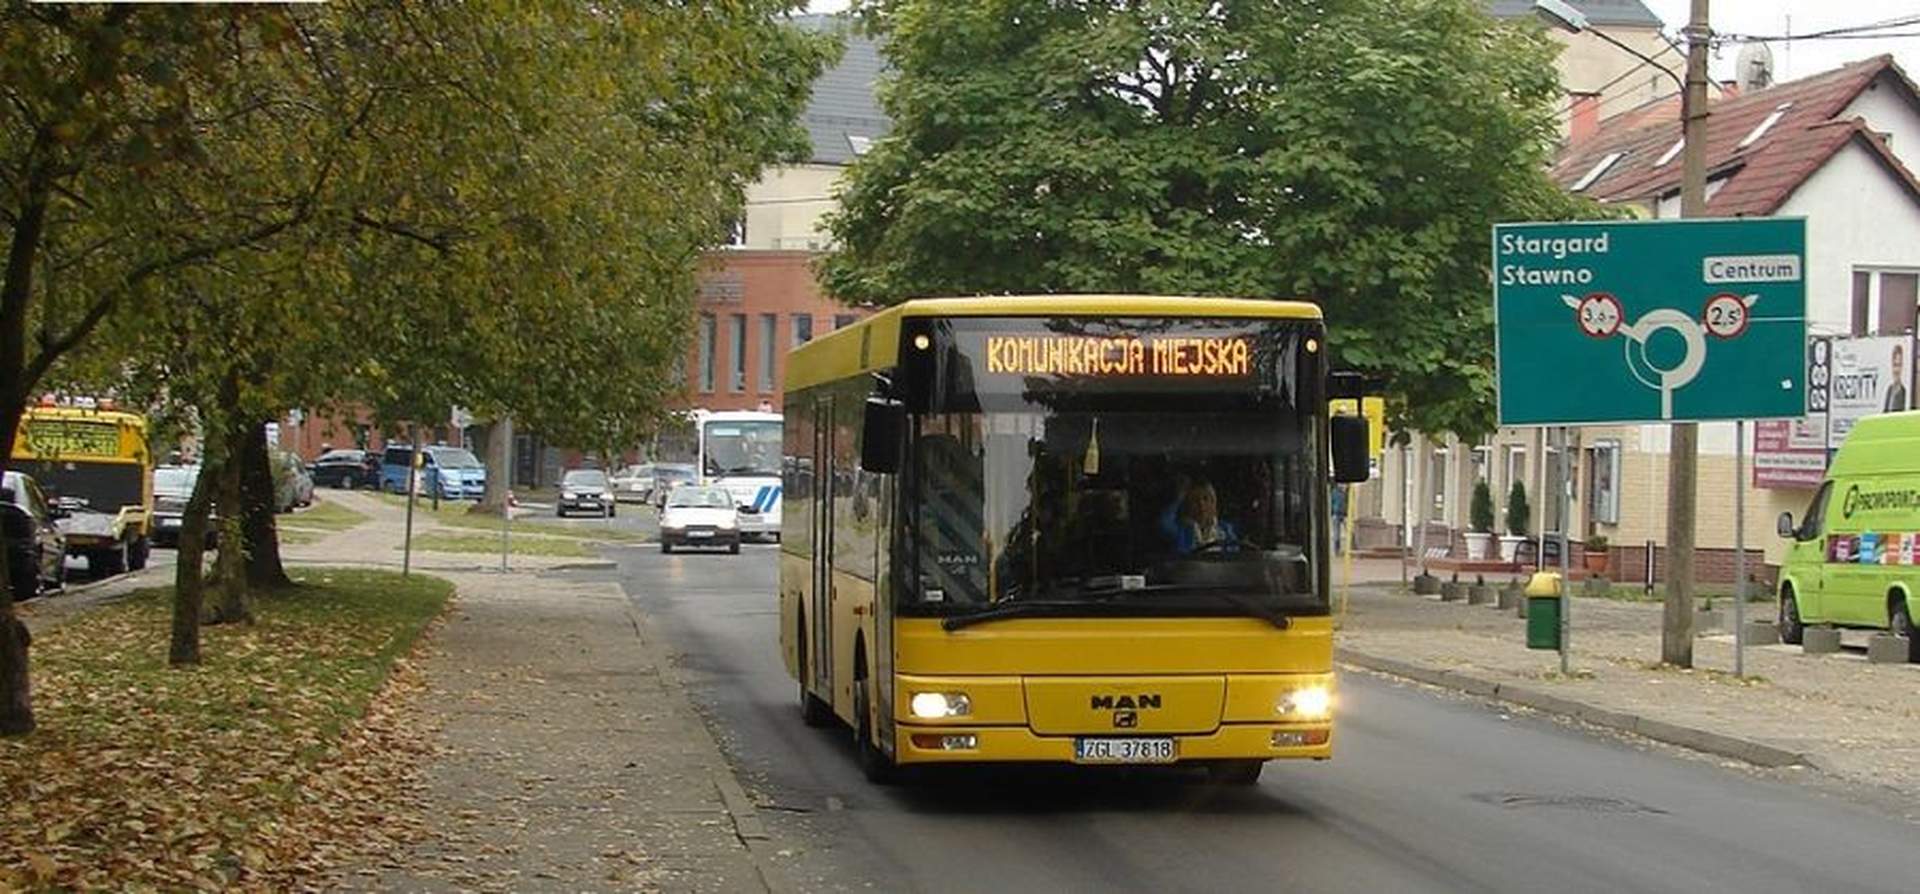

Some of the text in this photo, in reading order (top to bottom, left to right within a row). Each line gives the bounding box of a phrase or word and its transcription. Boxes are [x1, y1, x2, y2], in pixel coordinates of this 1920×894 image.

[1501, 232, 1608, 259] Stargard
[1501, 265, 1593, 285] Stawno
[1710, 262, 1793, 279] Centrum
[987, 337, 1247, 374] KOMUNIKACJA MIEJSKA
[938, 555, 977, 564] MAN
[1091, 694, 1162, 710] MAN
[1086, 741, 1170, 758] ZGL 37818
